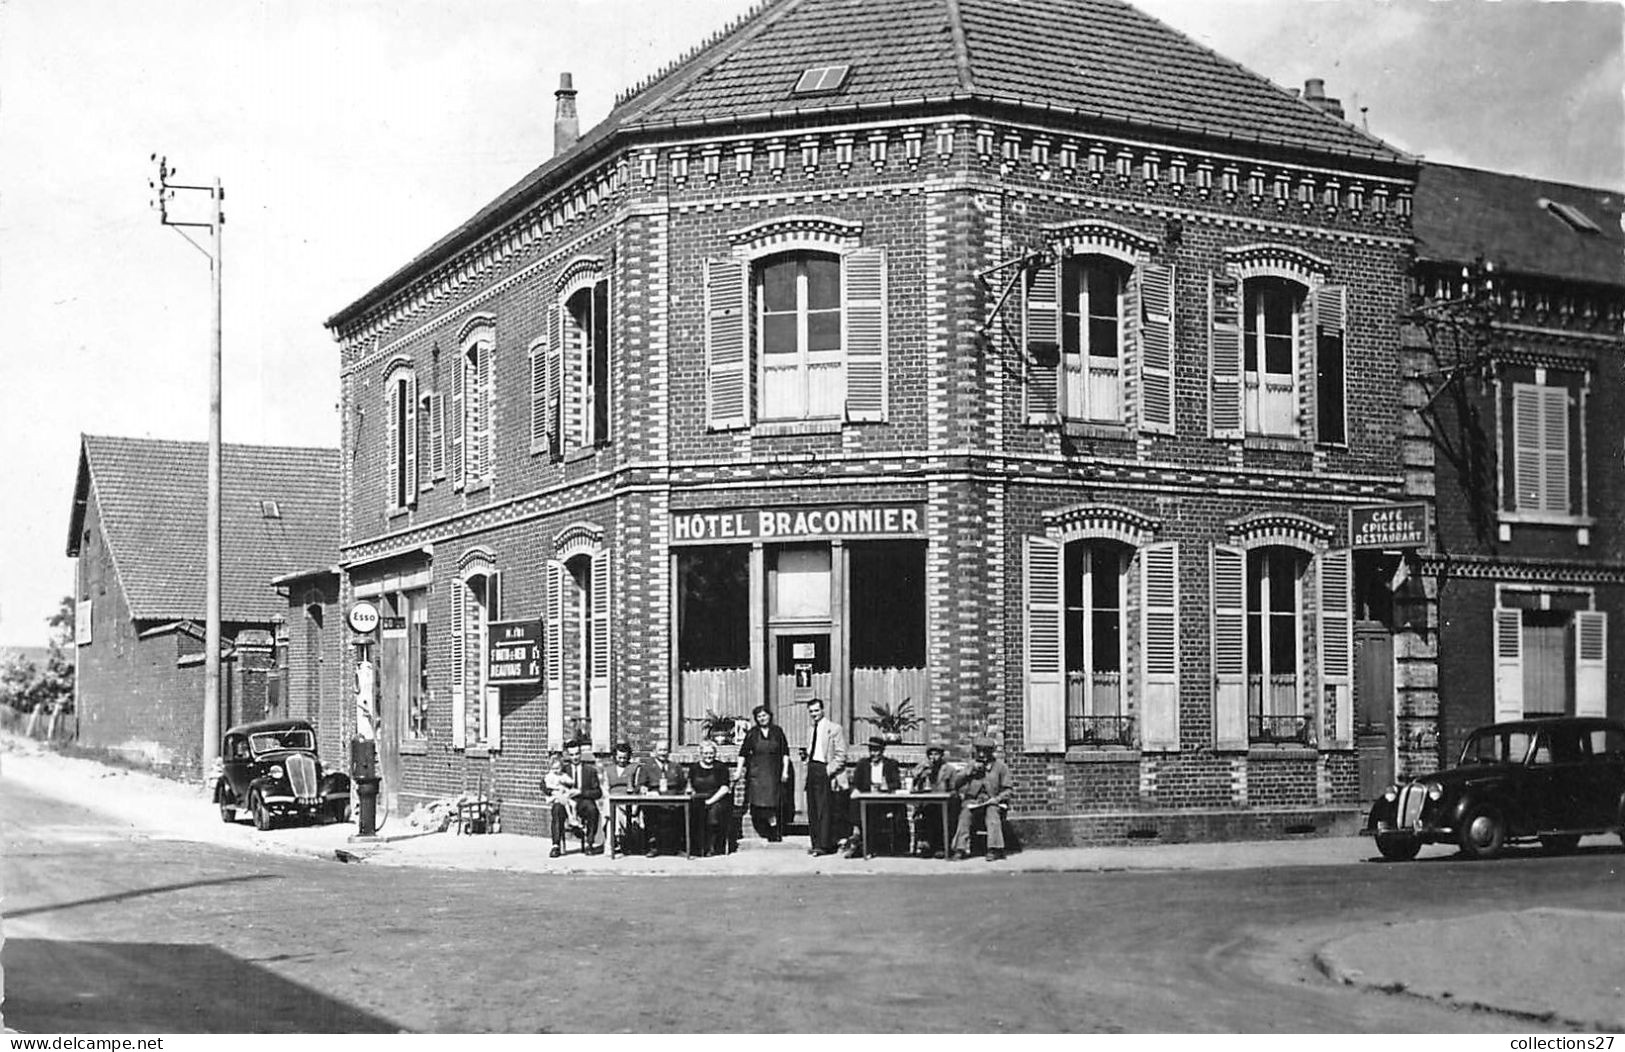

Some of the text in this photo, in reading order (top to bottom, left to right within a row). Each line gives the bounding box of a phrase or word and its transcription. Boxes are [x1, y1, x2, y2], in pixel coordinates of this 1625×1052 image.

[674, 508, 918, 538] HÔTEL BRACONNIER
[1355, 531, 1422, 544] RESTAURANT
